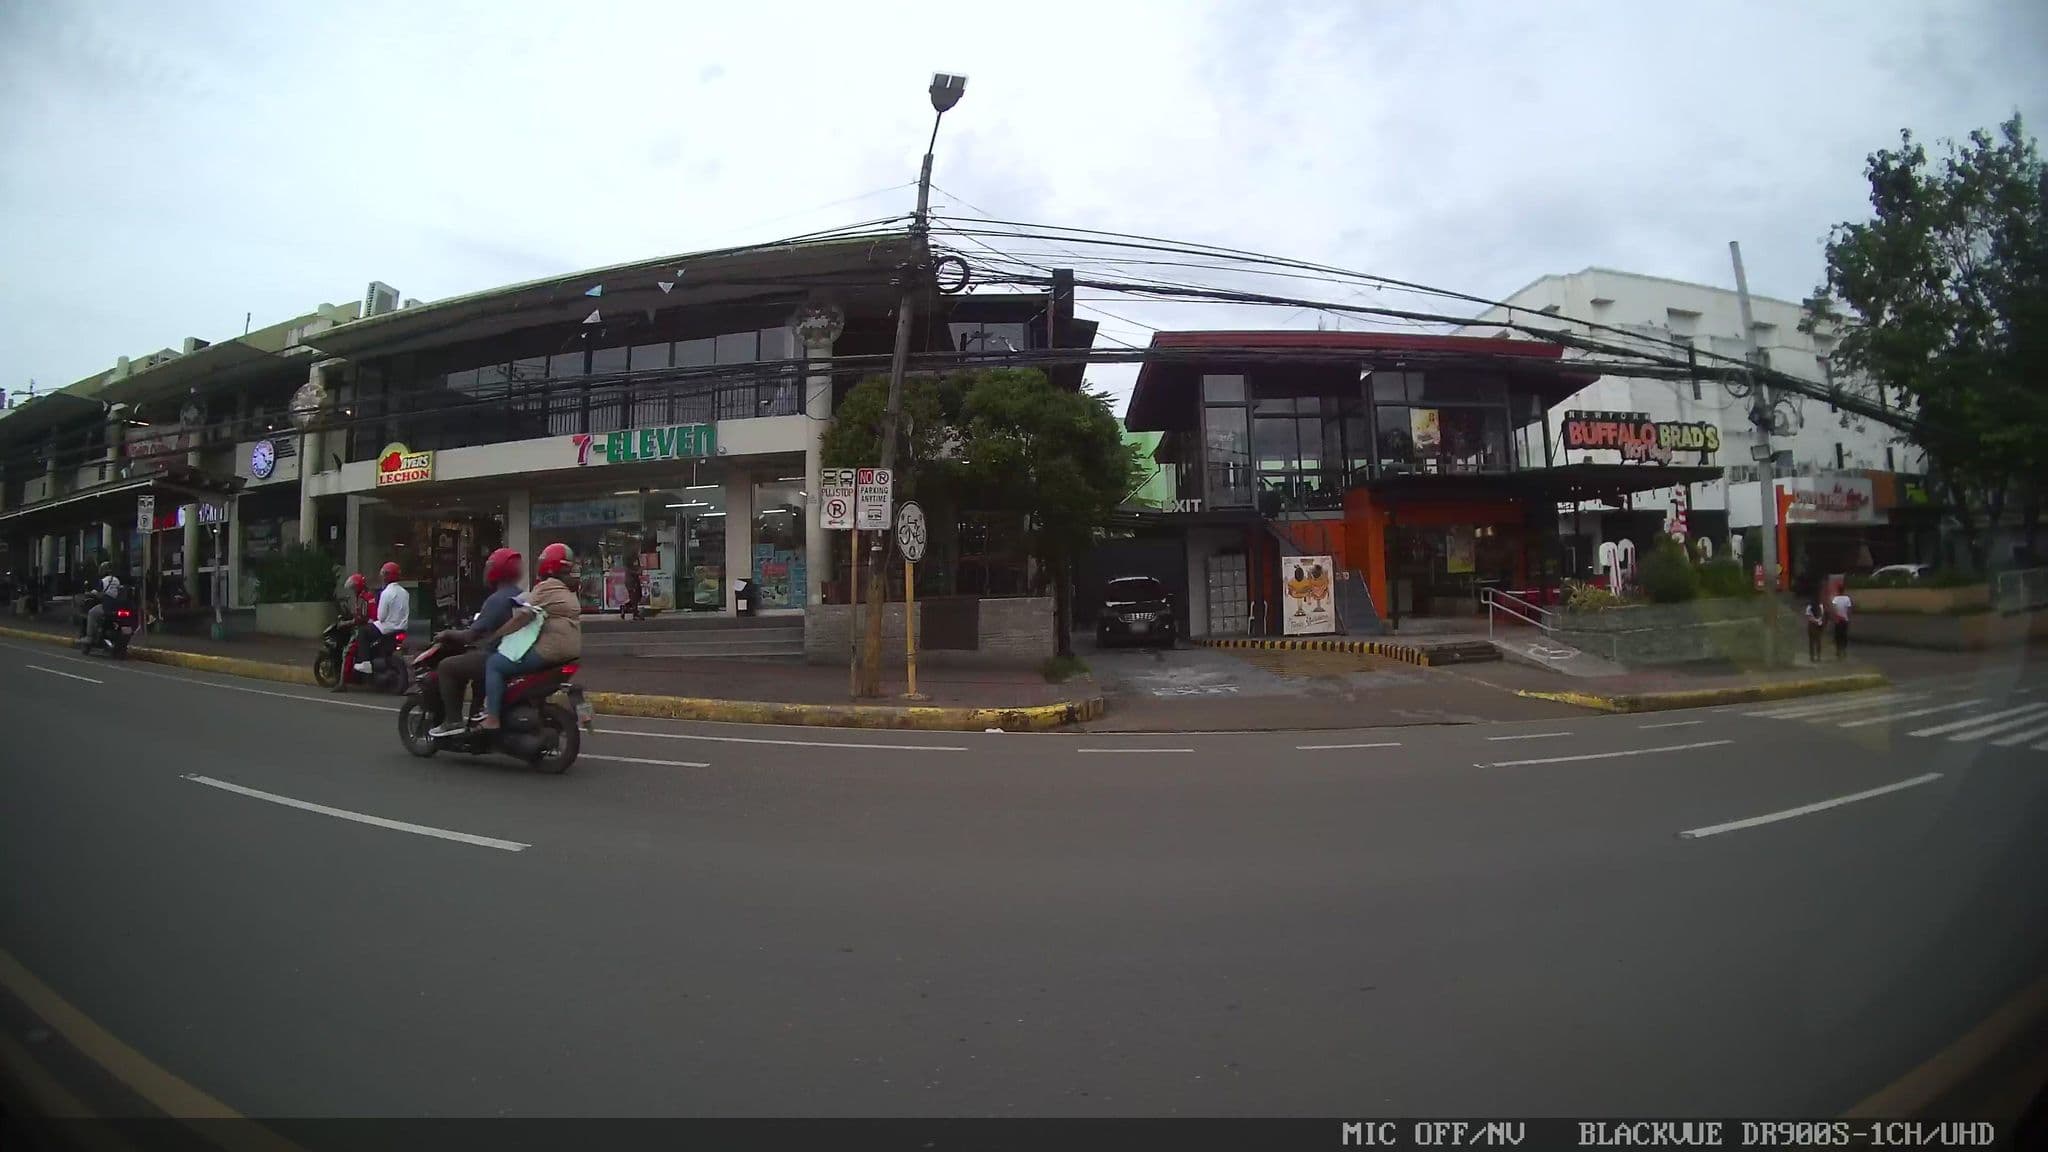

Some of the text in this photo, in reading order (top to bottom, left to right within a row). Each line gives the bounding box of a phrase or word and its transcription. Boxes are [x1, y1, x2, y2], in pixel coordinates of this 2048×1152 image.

[1568, 421, 1719, 450] BUFFALO BRAD'S
[379, 469, 430, 485] LECHON
[858, 470, 874, 485] NO
[836, 487, 854, 498] STOP
[860, 486, 889, 495] PARKING
[861, 494, 887, 503] ANYTIME
